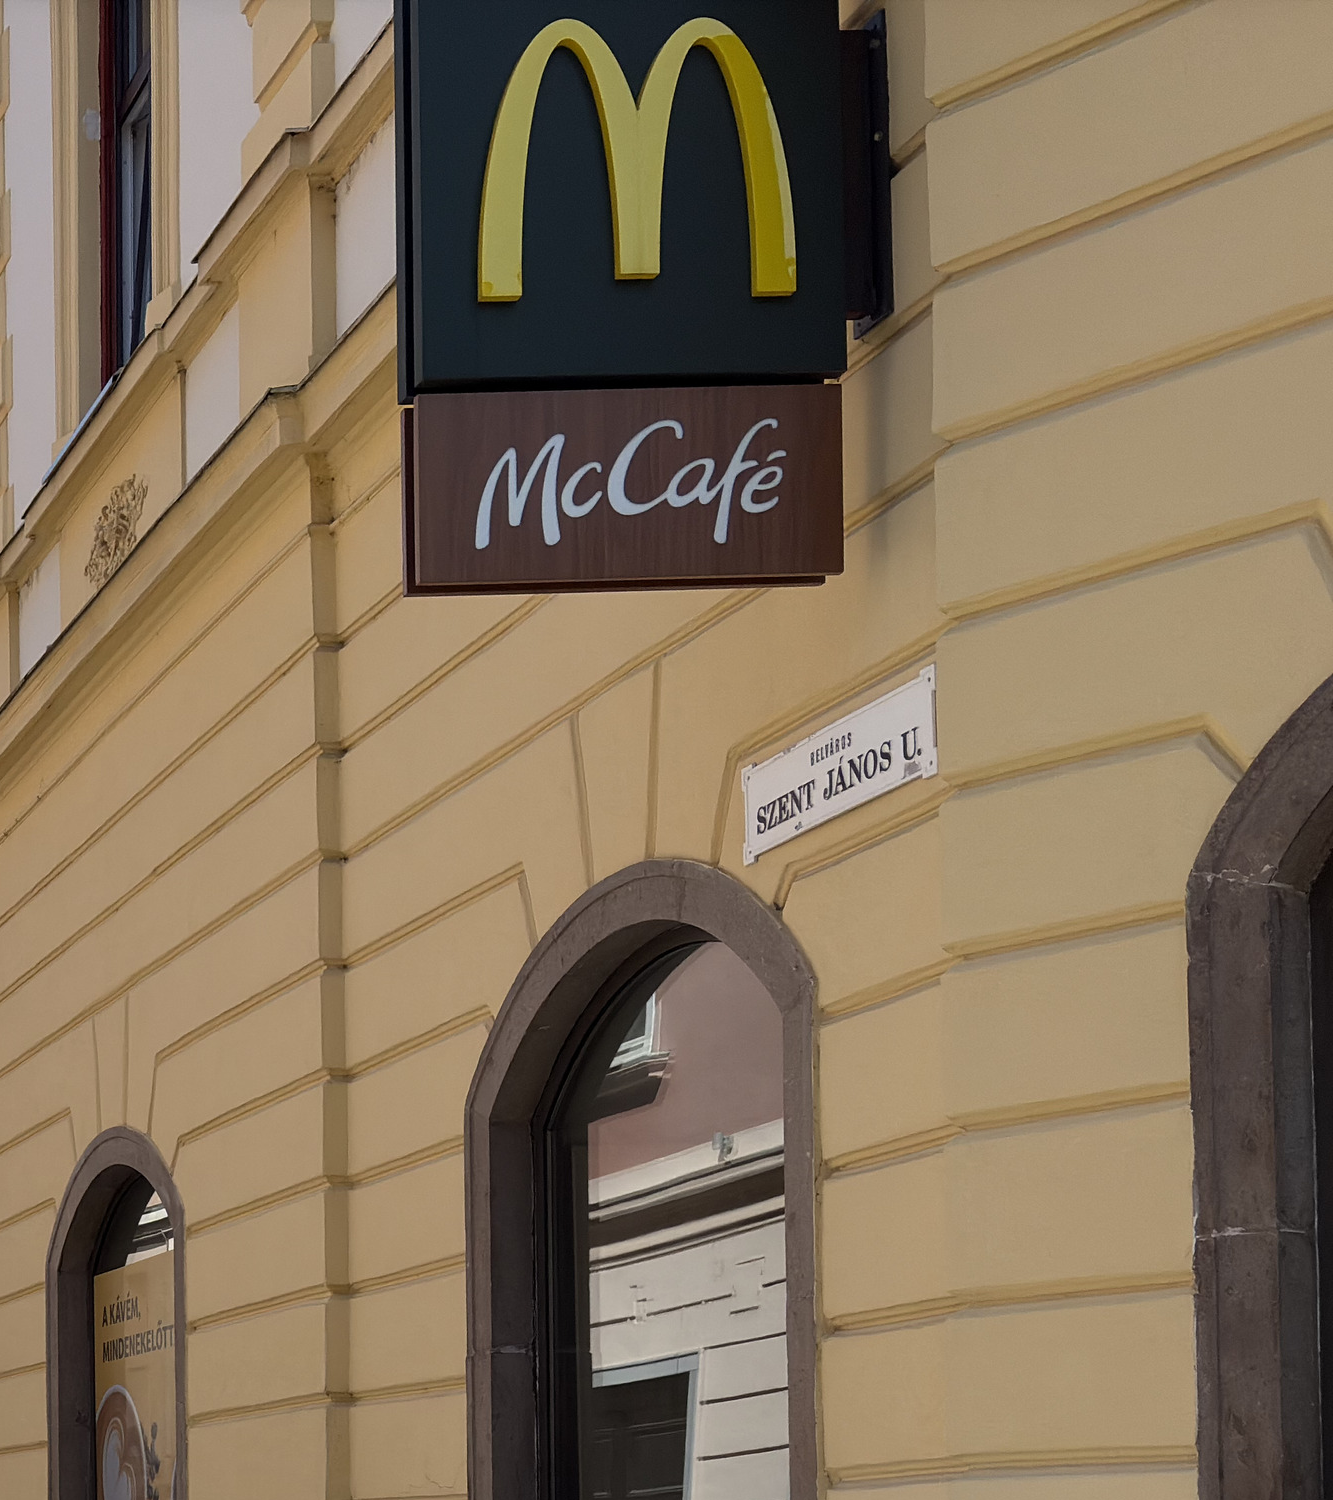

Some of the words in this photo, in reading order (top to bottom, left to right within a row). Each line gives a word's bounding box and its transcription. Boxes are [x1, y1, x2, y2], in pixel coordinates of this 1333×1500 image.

[474, 417, 787, 550] McCafé
[756, 778, 816, 836] SZENT
[822, 739, 892, 801] JÁNOS
[900, 726, 923, 761] U.
[809, 731, 853, 767] BELVÁROS
[101, 1305, 109, 1328] A
[109, 1290, 141, 1326] KÁVÉM,
